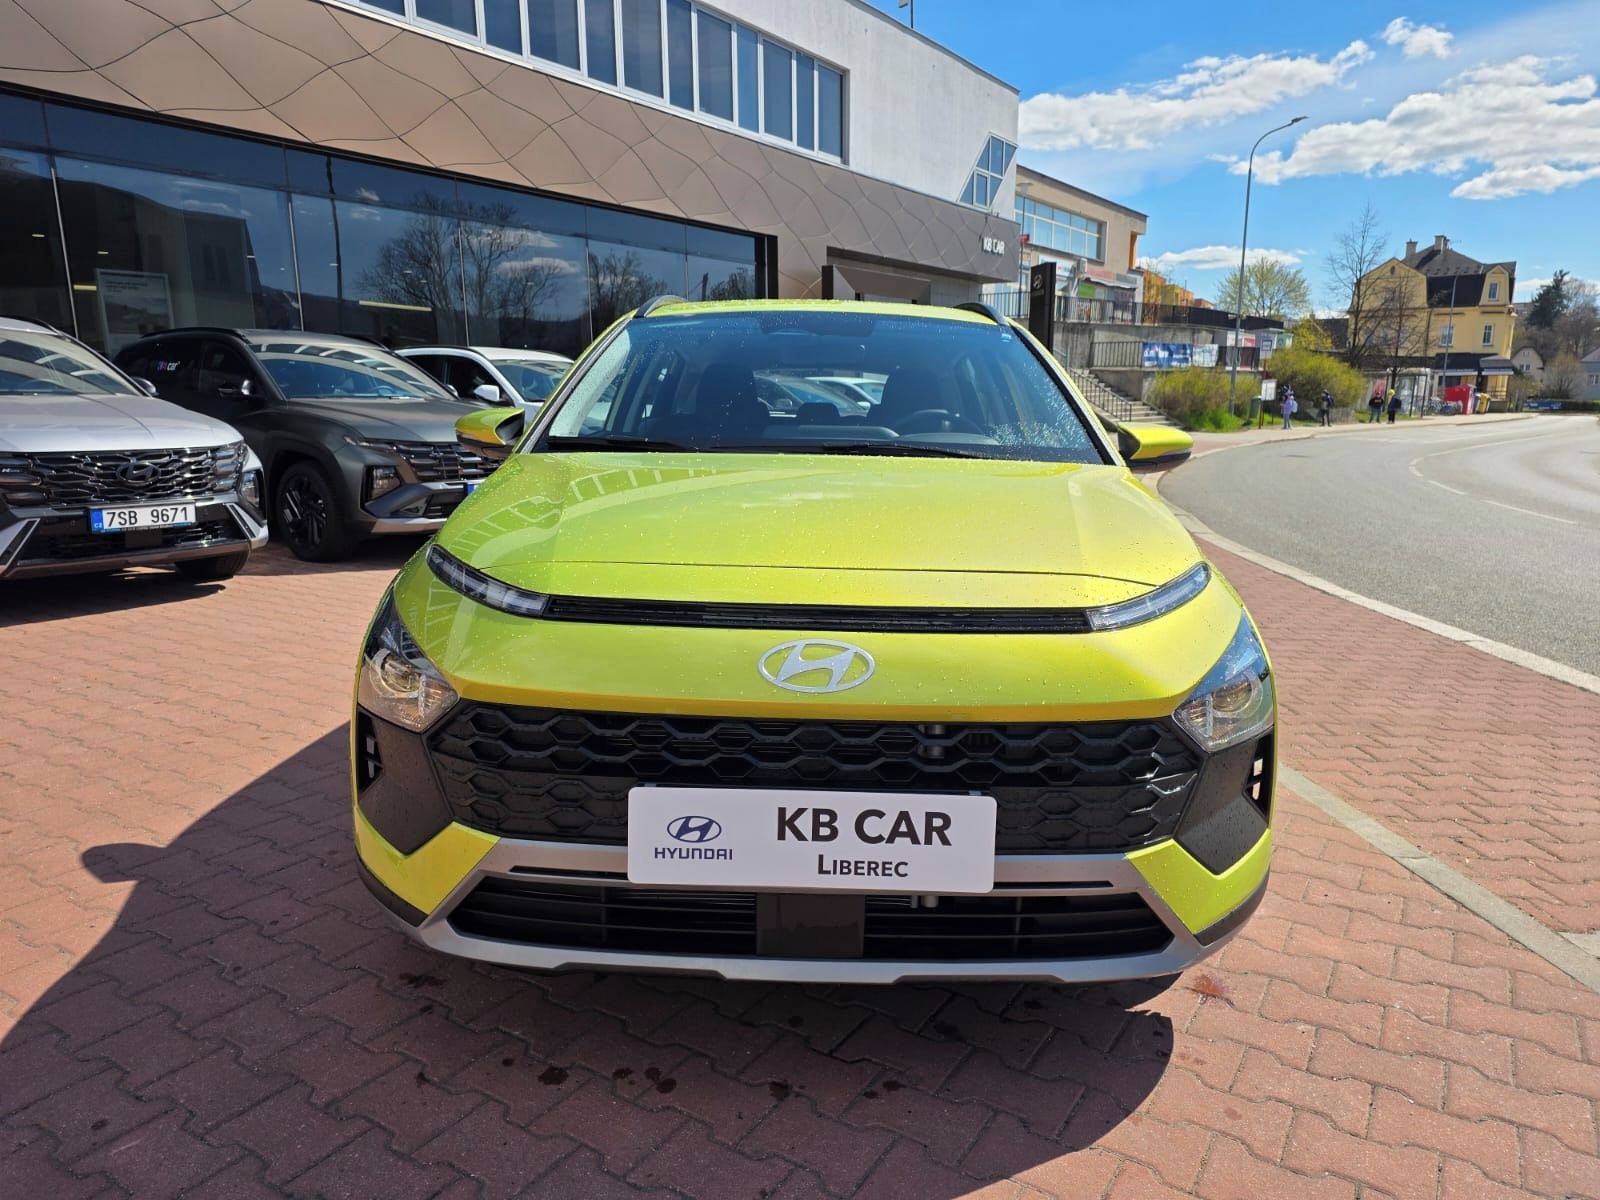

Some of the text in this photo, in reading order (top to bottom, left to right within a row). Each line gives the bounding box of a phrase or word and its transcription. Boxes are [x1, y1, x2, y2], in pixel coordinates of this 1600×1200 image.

[983, 236, 1005, 256] KB CAR
[106, 506, 188, 527] 7SB 9671
[777, 806, 953, 847] KB CAR
[654, 847, 733, 861] HYUNDAI
[817, 854, 909, 878] LIBEREC
